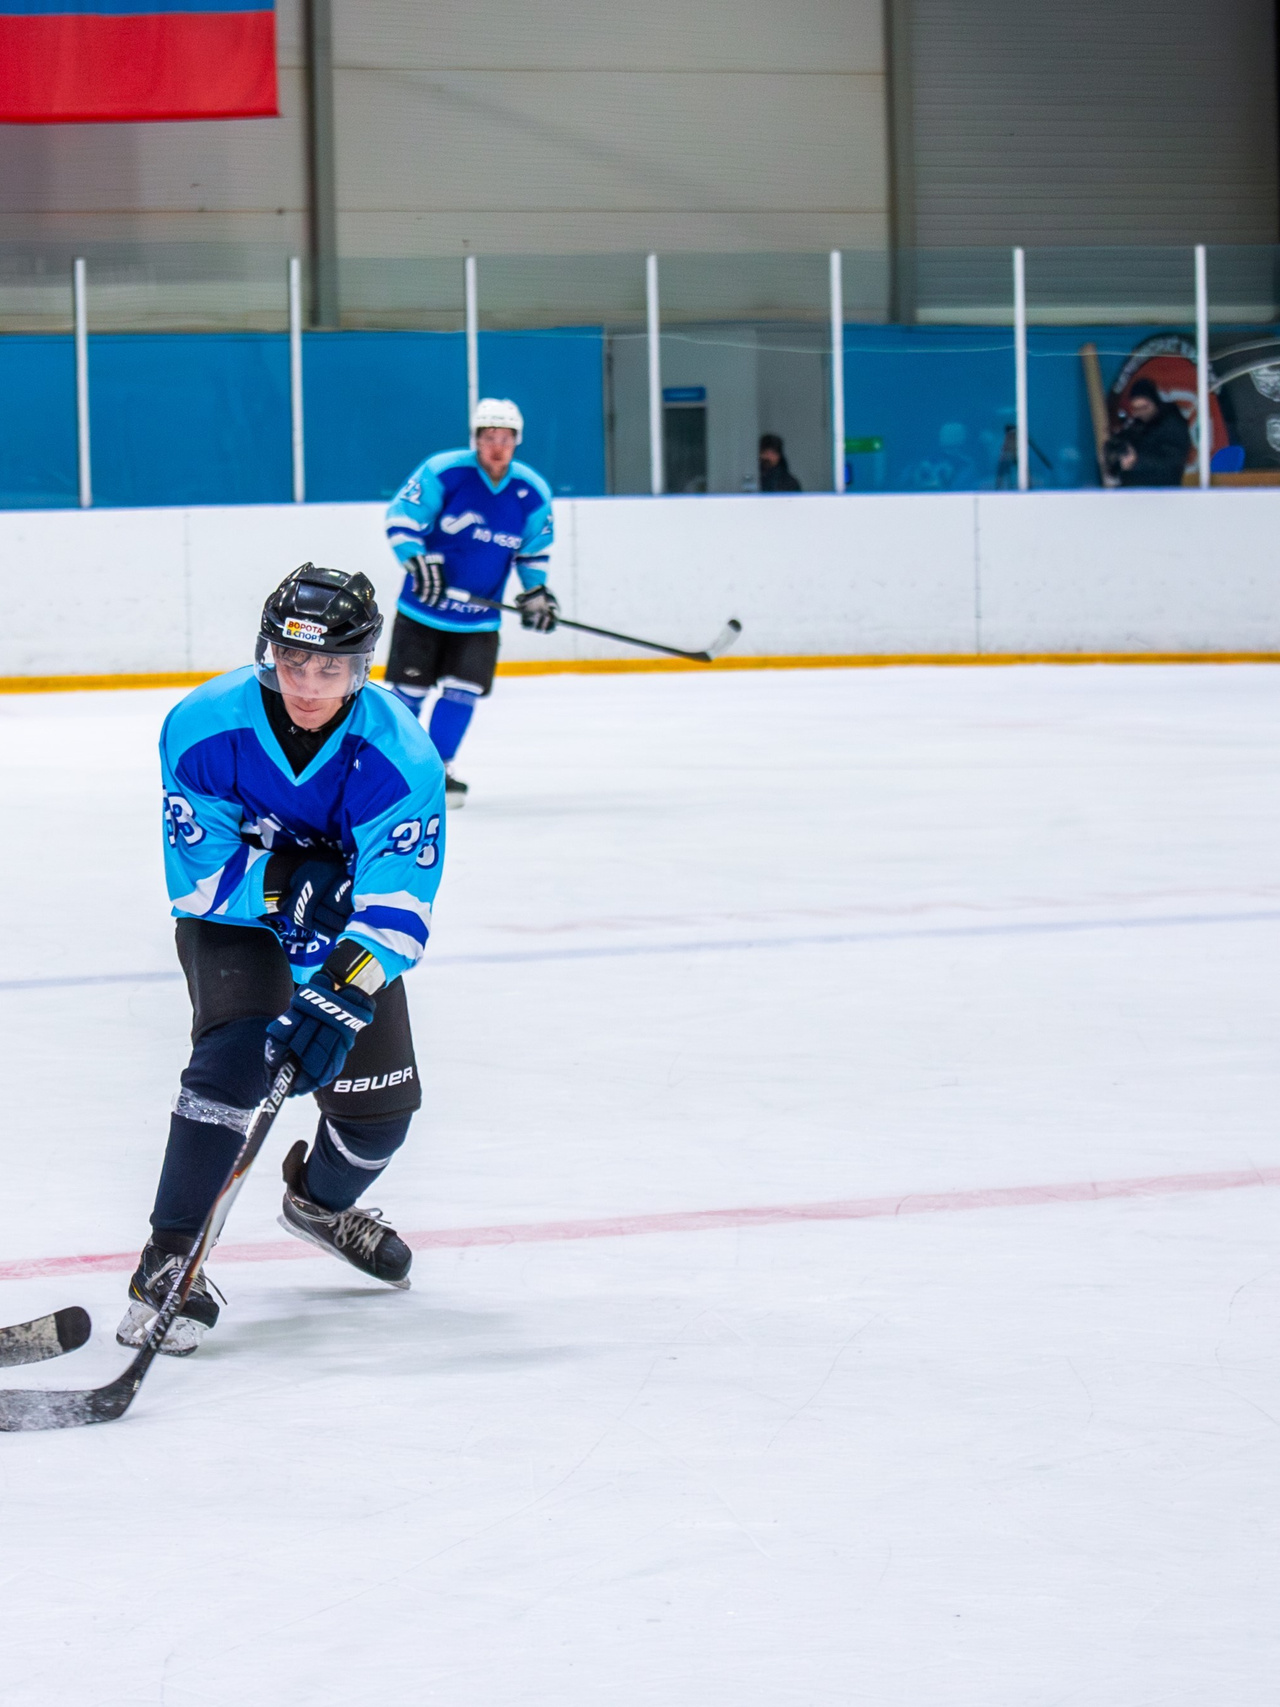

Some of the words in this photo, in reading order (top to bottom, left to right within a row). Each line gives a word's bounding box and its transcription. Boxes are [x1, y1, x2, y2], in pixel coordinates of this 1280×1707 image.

[288, 620, 323, 634] ВОРОТА
[293, 629, 323, 642] СПОРТ
[333, 1066, 414, 1093] BAUER
